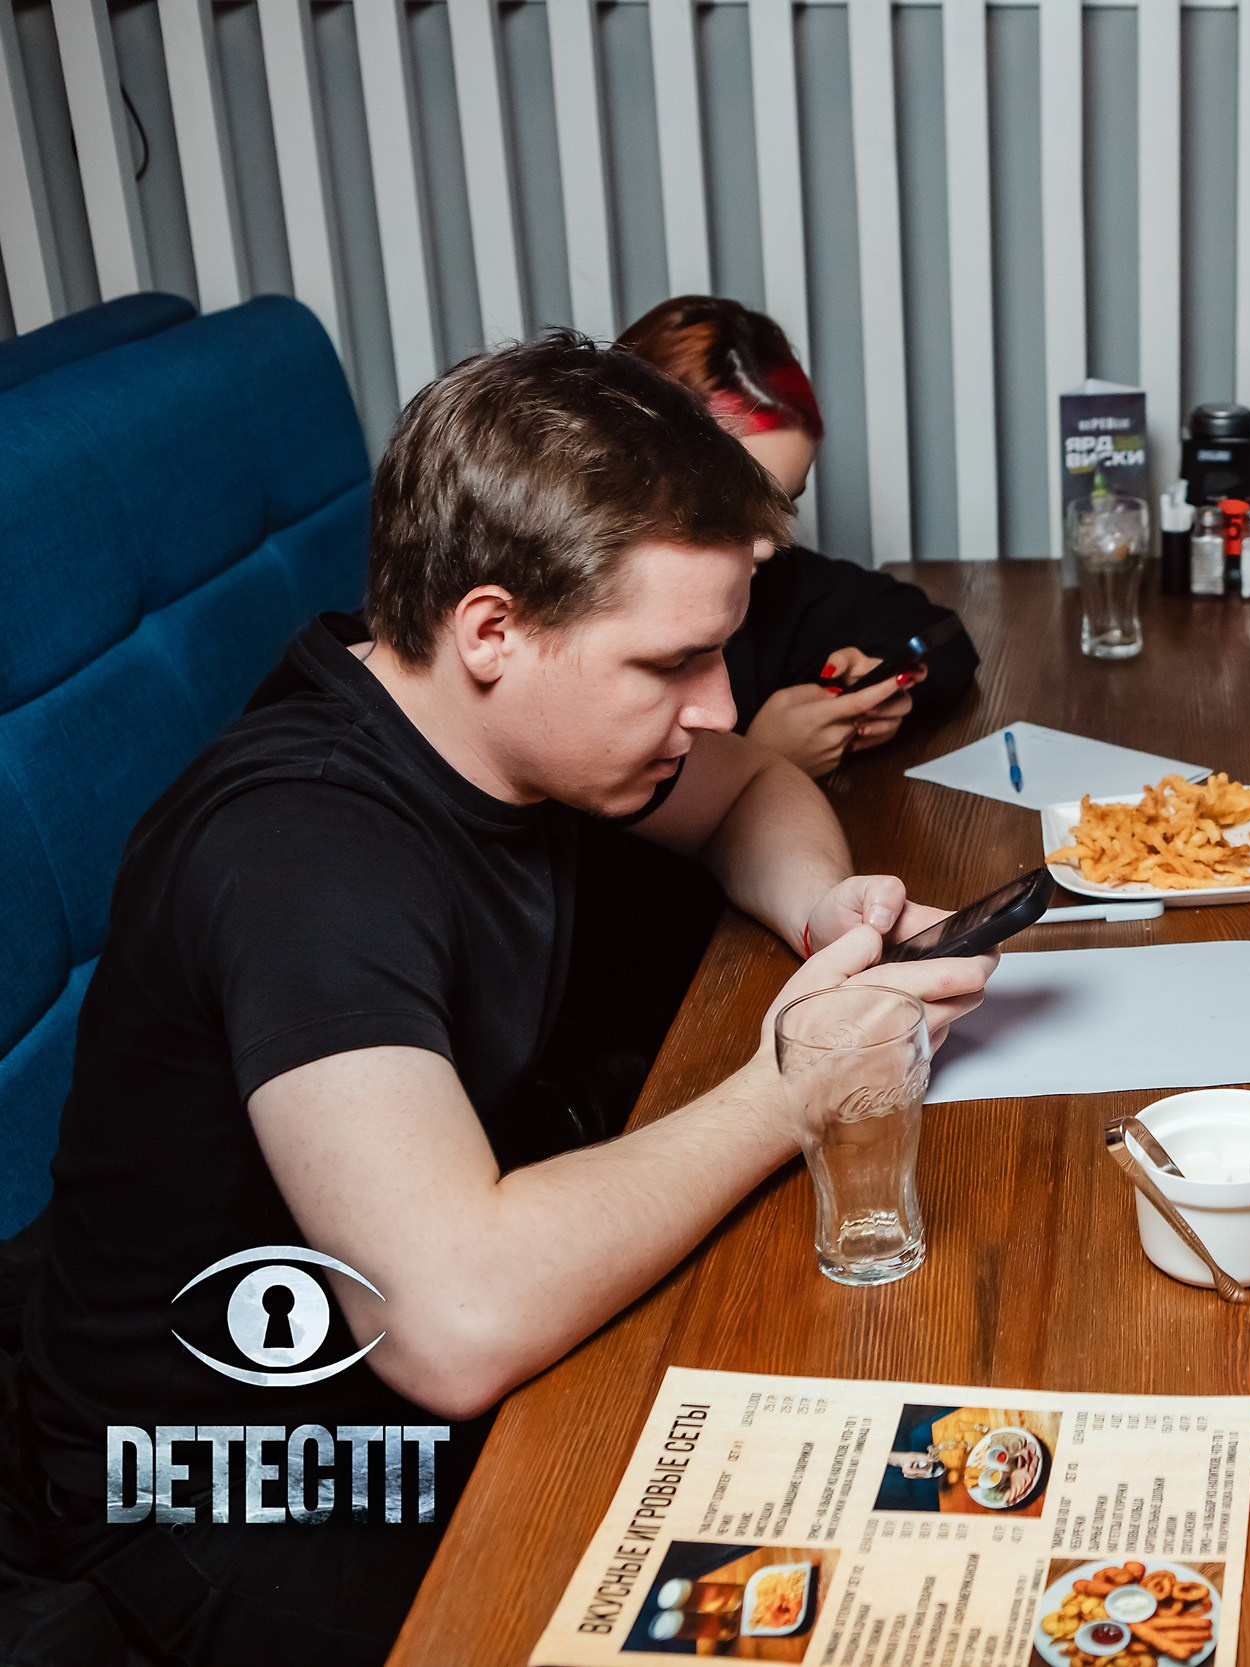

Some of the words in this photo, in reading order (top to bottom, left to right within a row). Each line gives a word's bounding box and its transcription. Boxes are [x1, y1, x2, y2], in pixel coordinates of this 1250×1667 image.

[574, 1544, 652, 1634] ВКУСНЫЕ
[619, 1456, 691, 1541] ИГРОВЫЕ
[658, 1403, 714, 1453] СЕТЫ
